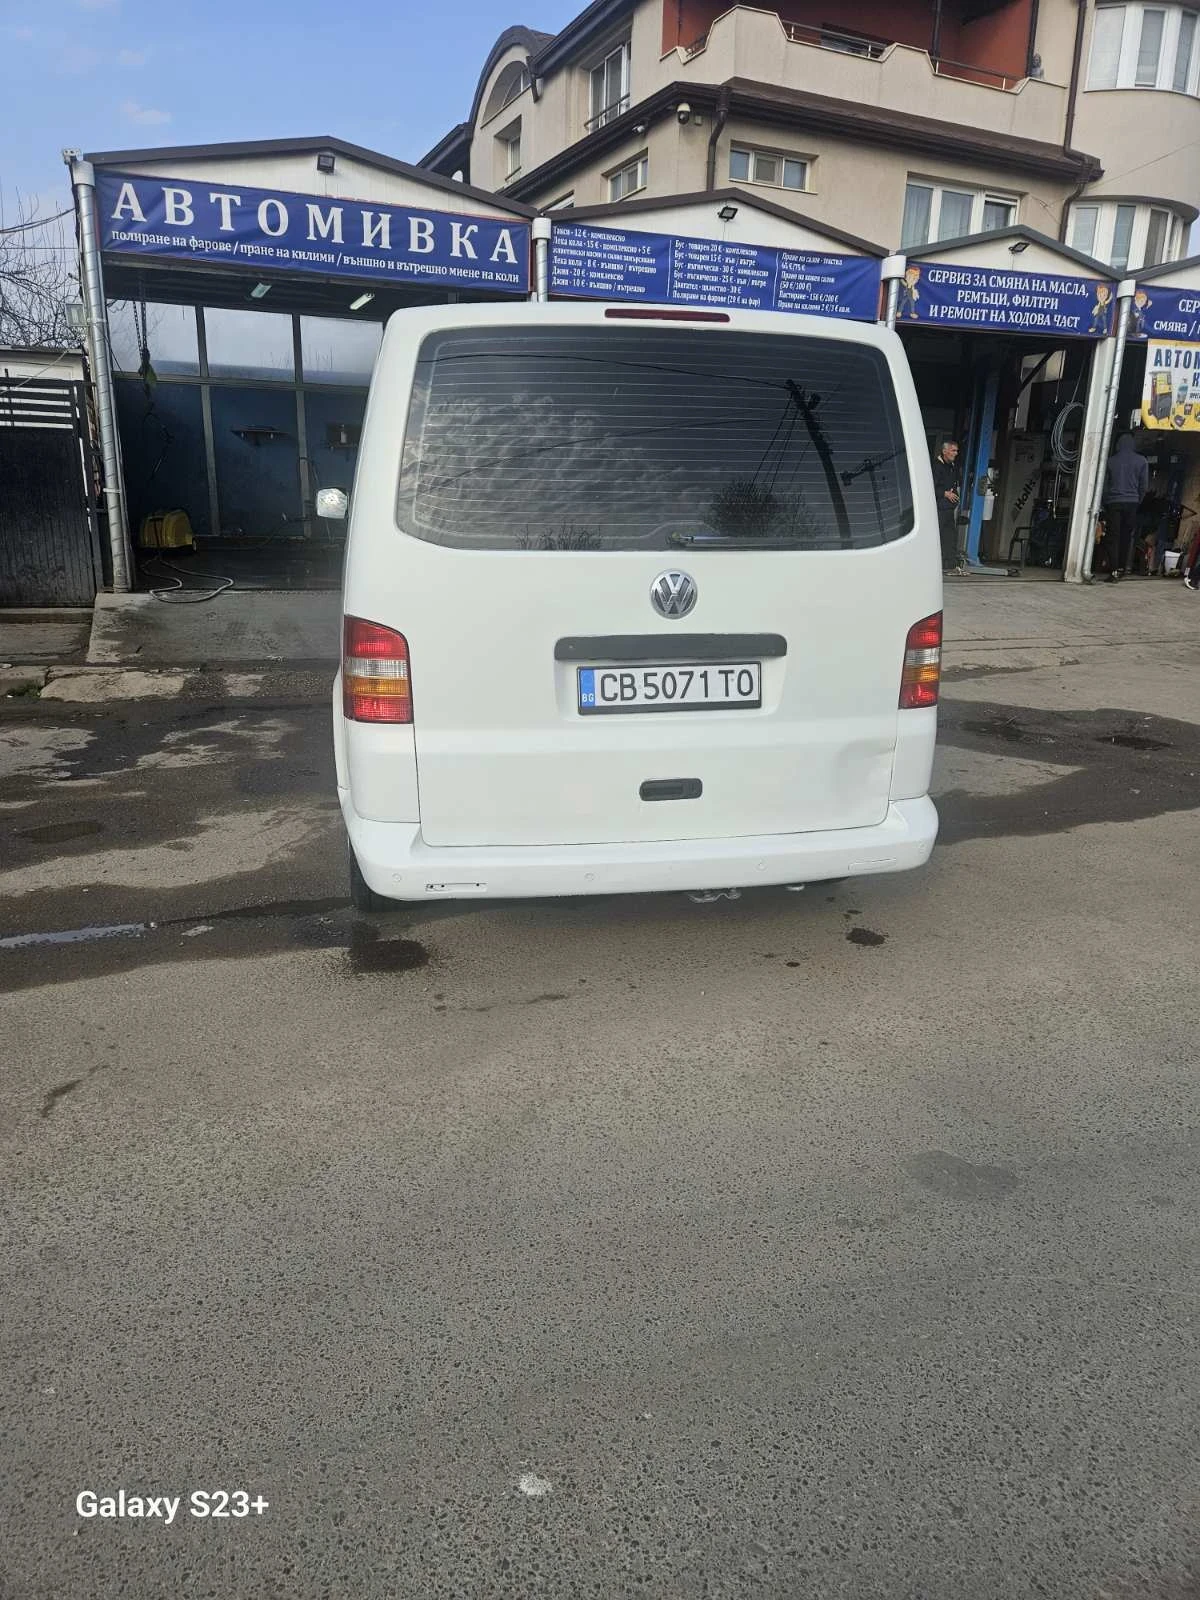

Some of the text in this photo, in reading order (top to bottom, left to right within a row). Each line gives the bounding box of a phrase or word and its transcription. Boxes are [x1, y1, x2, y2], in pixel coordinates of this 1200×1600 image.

[111, 182, 518, 264] АВТОМИВКА
[575, 228, 582, 237] 12
[112, 230, 171, 246] полиране
[172, 236, 186, 247] на
[190, 235, 232, 252] фарове
[240, 243, 274, 257] пране
[276, 247, 291, 258] на
[292, 250, 334, 264] килими
[344, 256, 386, 269] външно
[388, 260, 396, 270] и
[396, 261, 447, 276] вътрешно
[450, 268, 480, 278] миене
[482, 270, 494, 281] на
[496, 272, 519, 283] коли
[928, 270, 1089, 298] СЕРВИЗ ЗА СМЯНА НА МАСЛА,
[957, 290, 1059, 310] РЕМЪЦИ, ФИЛТРИ
[929, 305, 1081, 328] И РЕМОНТ НА ХОДОВА ЧАСТ
[1154, 320, 1187, 333] смяна
[581, 693, 595, 702] BG
